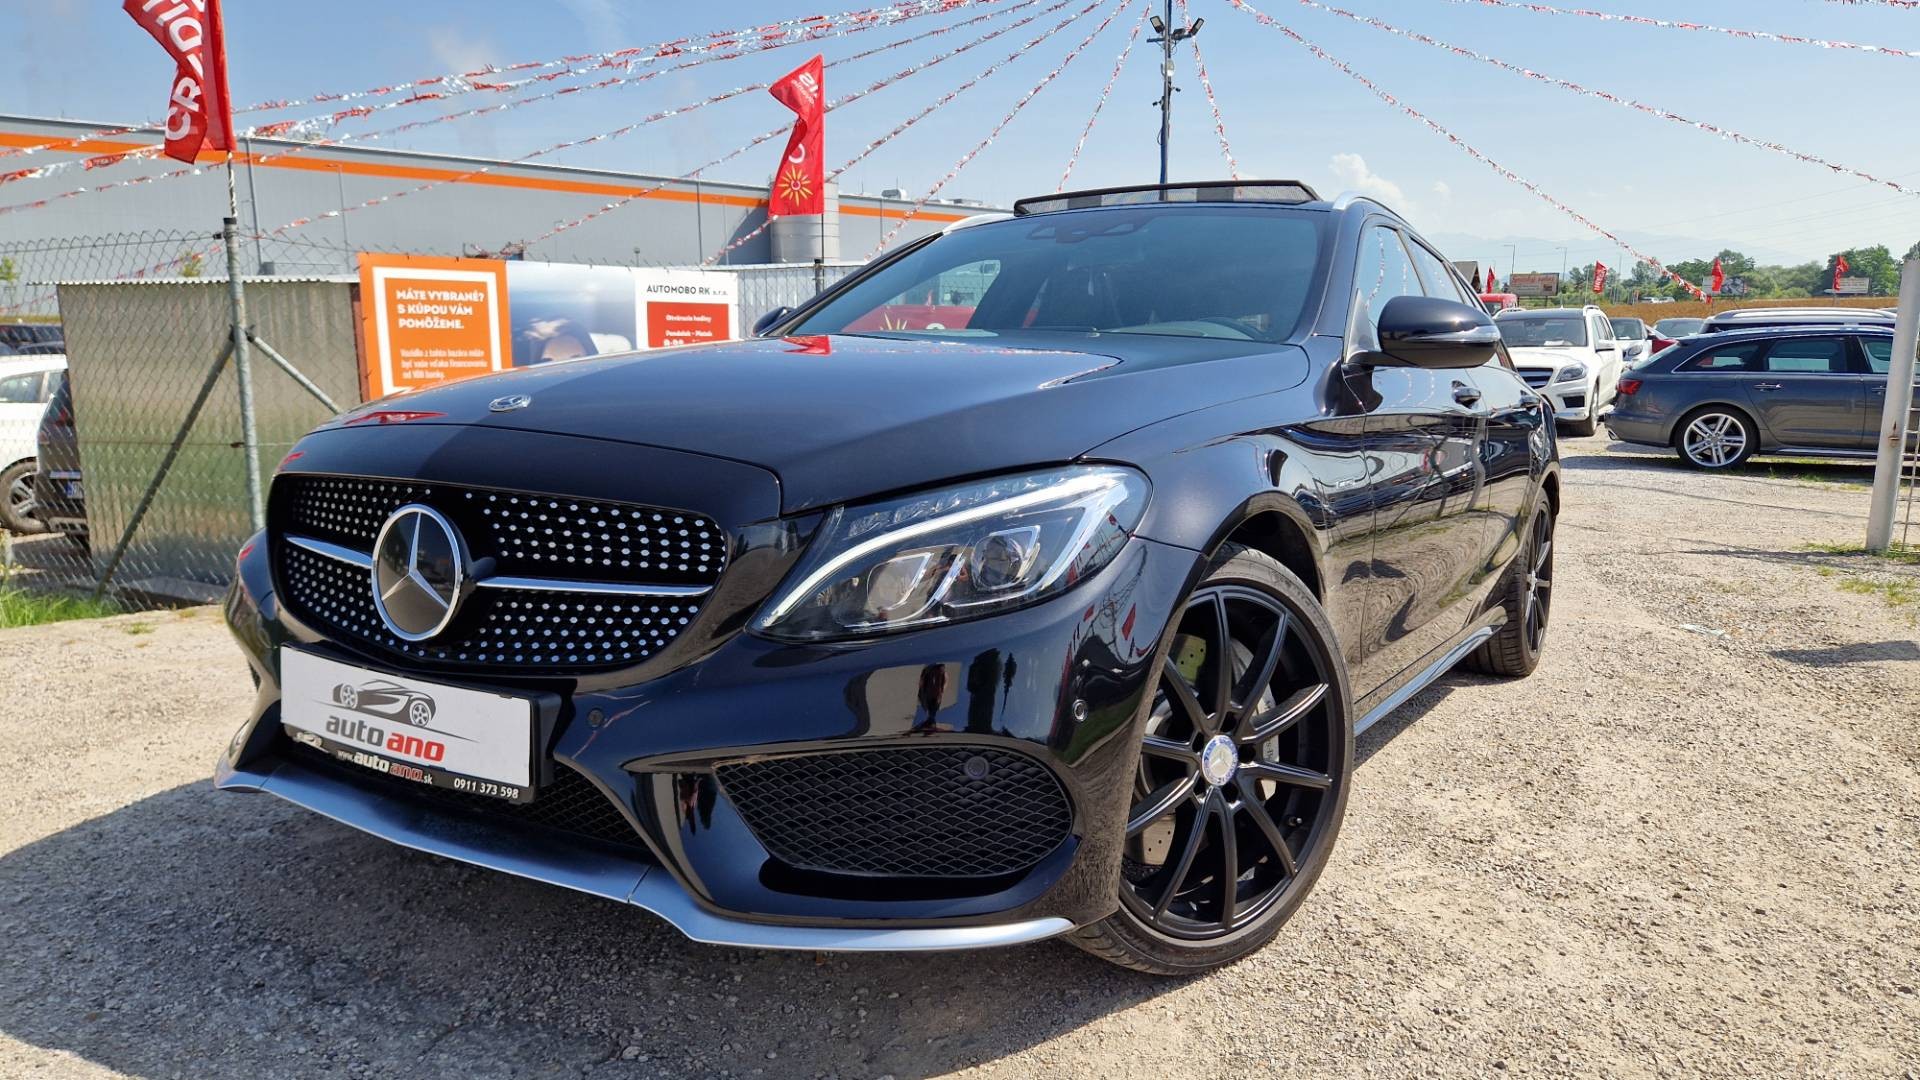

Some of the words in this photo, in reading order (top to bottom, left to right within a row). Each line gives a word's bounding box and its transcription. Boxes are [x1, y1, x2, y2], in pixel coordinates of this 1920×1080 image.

[396, 287, 426, 300] MÁTE
[428, 288, 485, 302] VYBRANÉ?
[646, 284, 697, 295] AUTOMOBO
[699, 286, 711, 296] RK
[397, 304, 406, 315] S
[449, 302, 473, 316] VÁM
[325, 715, 385, 747] auto
[386, 731, 446, 762] ano
[453, 777, 477, 791] 0911
[479, 782, 498, 796] 373
[500, 785, 519, 799] 598
